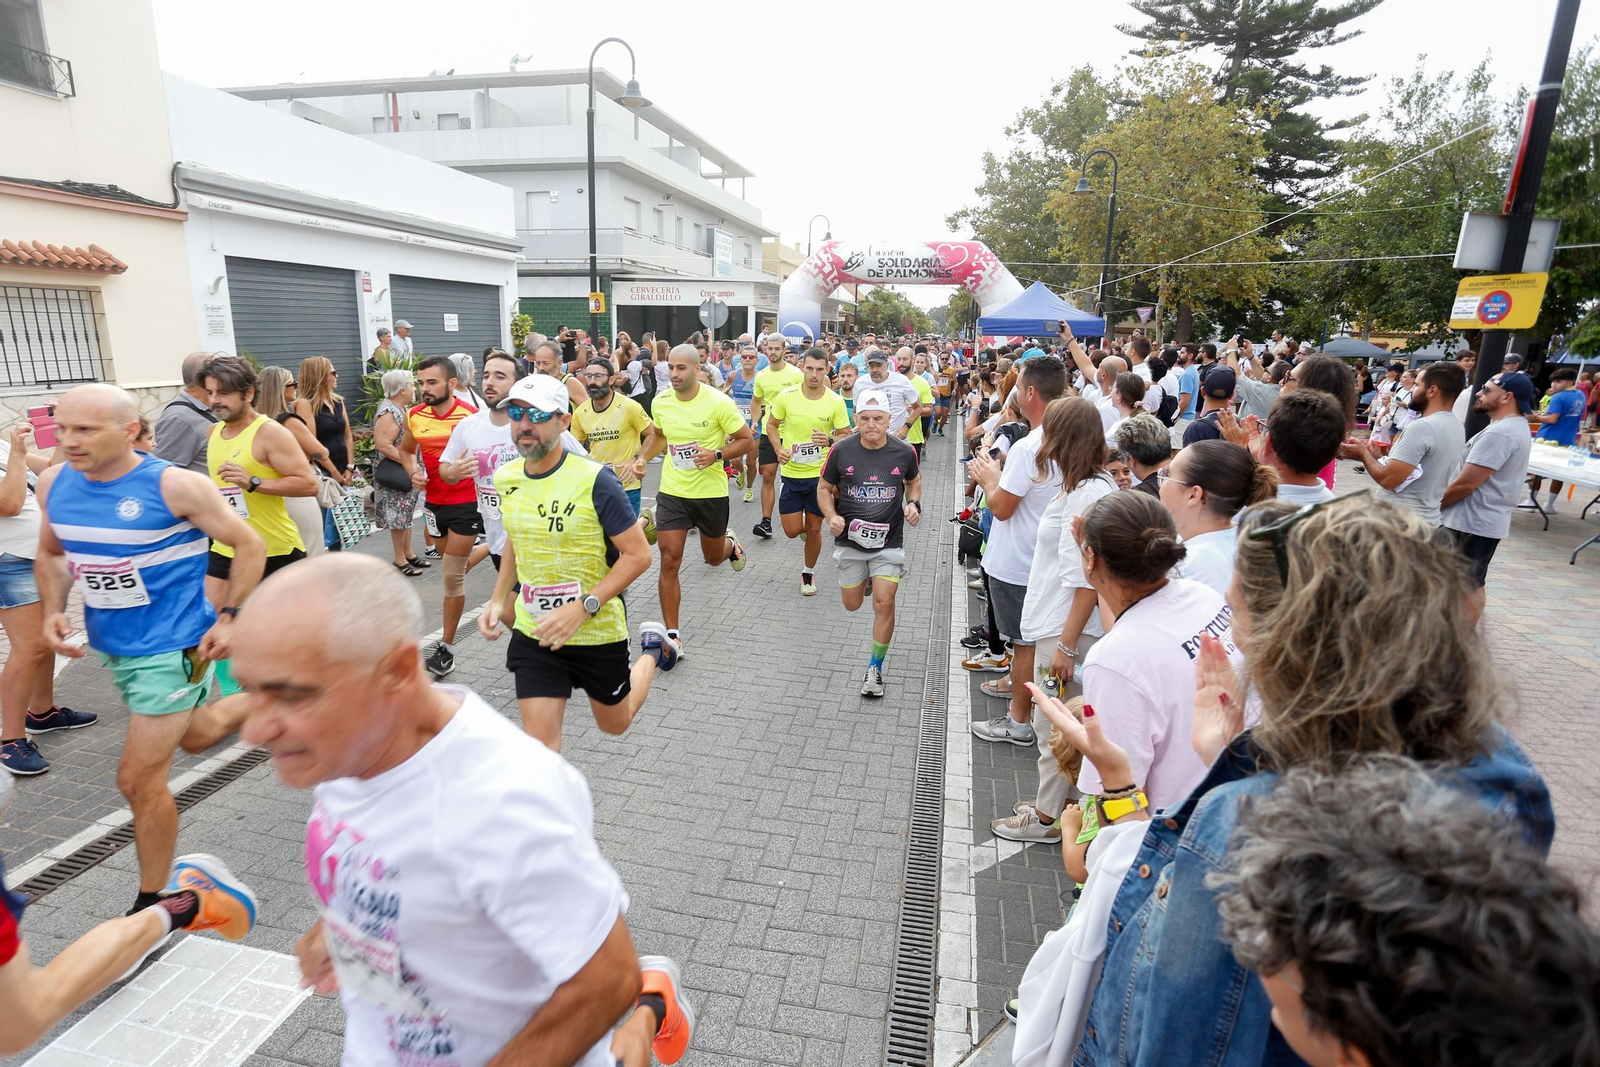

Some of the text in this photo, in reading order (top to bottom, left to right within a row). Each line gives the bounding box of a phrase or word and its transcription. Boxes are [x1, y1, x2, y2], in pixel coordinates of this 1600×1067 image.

[868, 244, 906, 257] Carrera
[877, 257, 942, 268] SOLIDARIA
[867, 268, 953, 278] DE PALMONES
[630, 286, 681, 294] CERVECERÍA
[630, 293, 682, 302] GIRALDILLO
[801, 446, 820, 456] 561
[847, 485, 897, 499] MADRID
[548, 516, 564, 532] 76
[861, 529, 886, 539] 551
[86, 573, 136, 590] 525
[1181, 604, 1231, 660] FOTUNE
